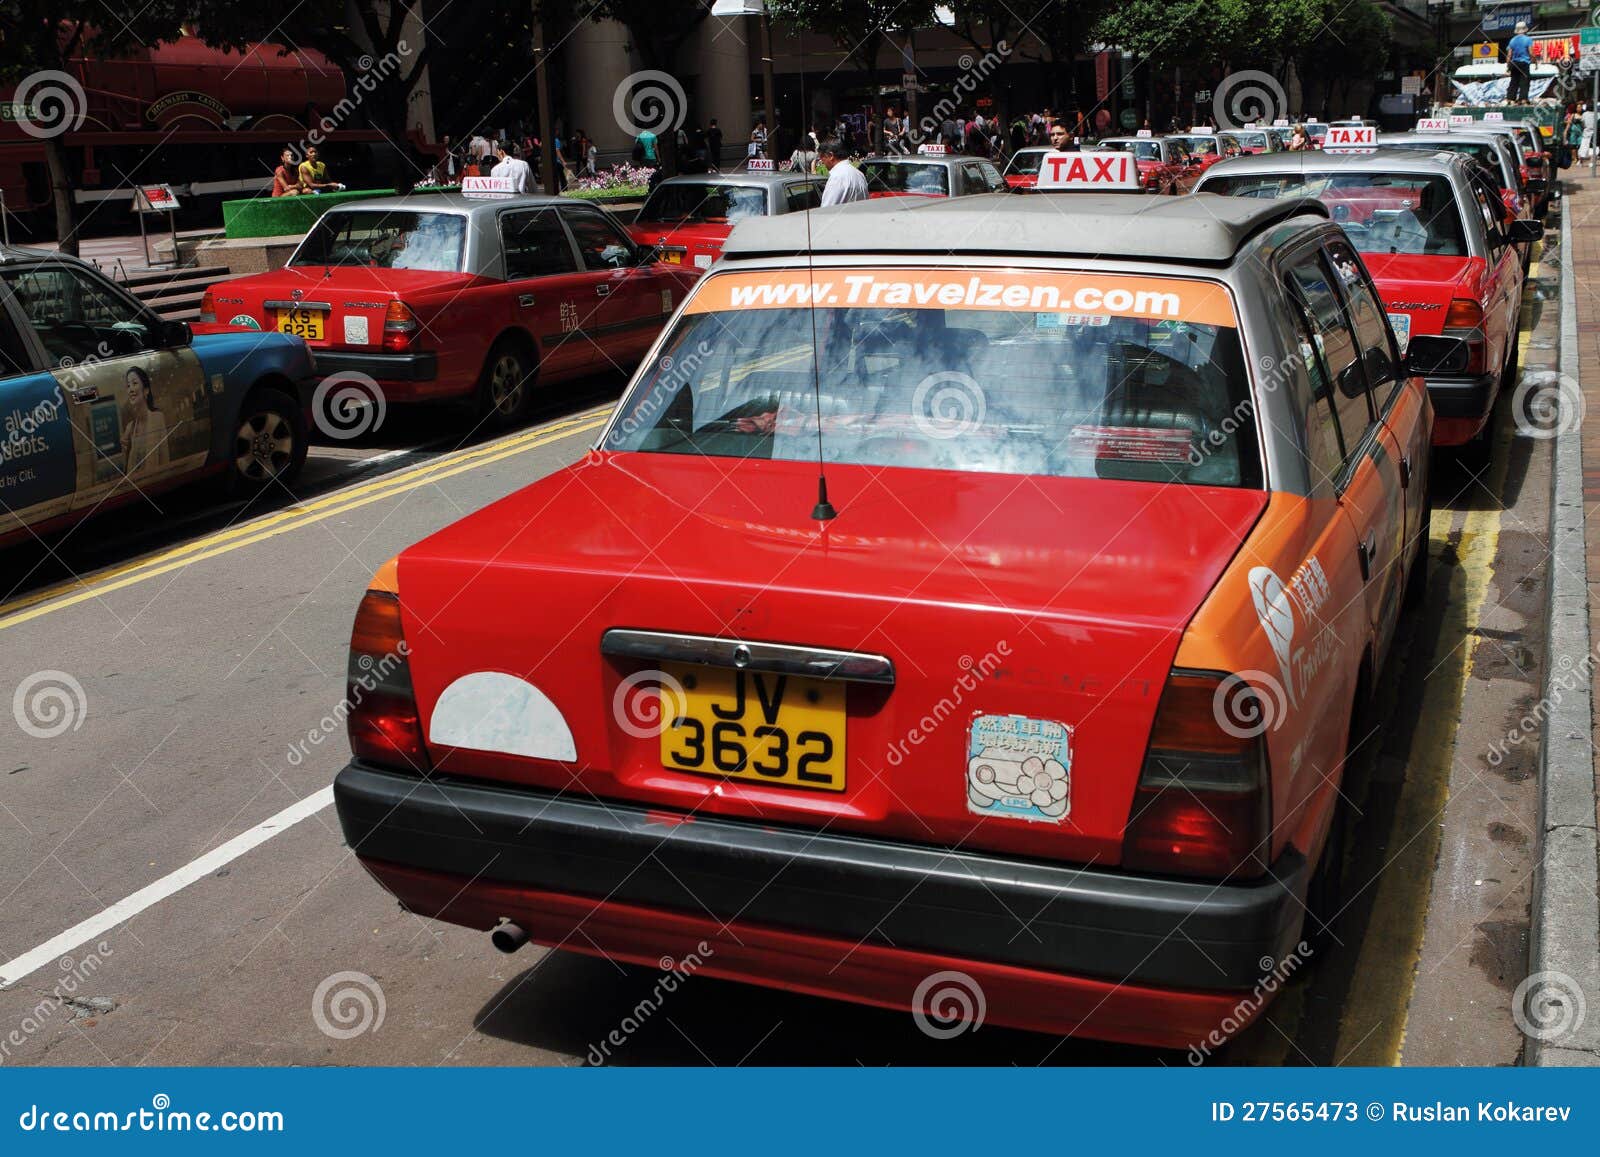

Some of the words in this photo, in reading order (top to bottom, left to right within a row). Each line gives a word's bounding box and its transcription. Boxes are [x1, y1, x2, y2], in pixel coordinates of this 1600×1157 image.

[1420, 120, 1447, 129] TAXI
[1331, 130, 1372, 144] TAXI
[750, 160, 773, 168] TAXI
[1047, 157, 1128, 183] TAXI
[465, 178, 492, 190] TAXI
[729, 273, 1181, 316] www.Travelzen.com
[289, 309, 311, 324] KS
[560, 315, 579, 333] TAXI
[284, 324, 318, 339] 825
[5, 408, 22, 432] all
[711, 668, 787, 725] JV
[671, 716, 833, 784] 3632
